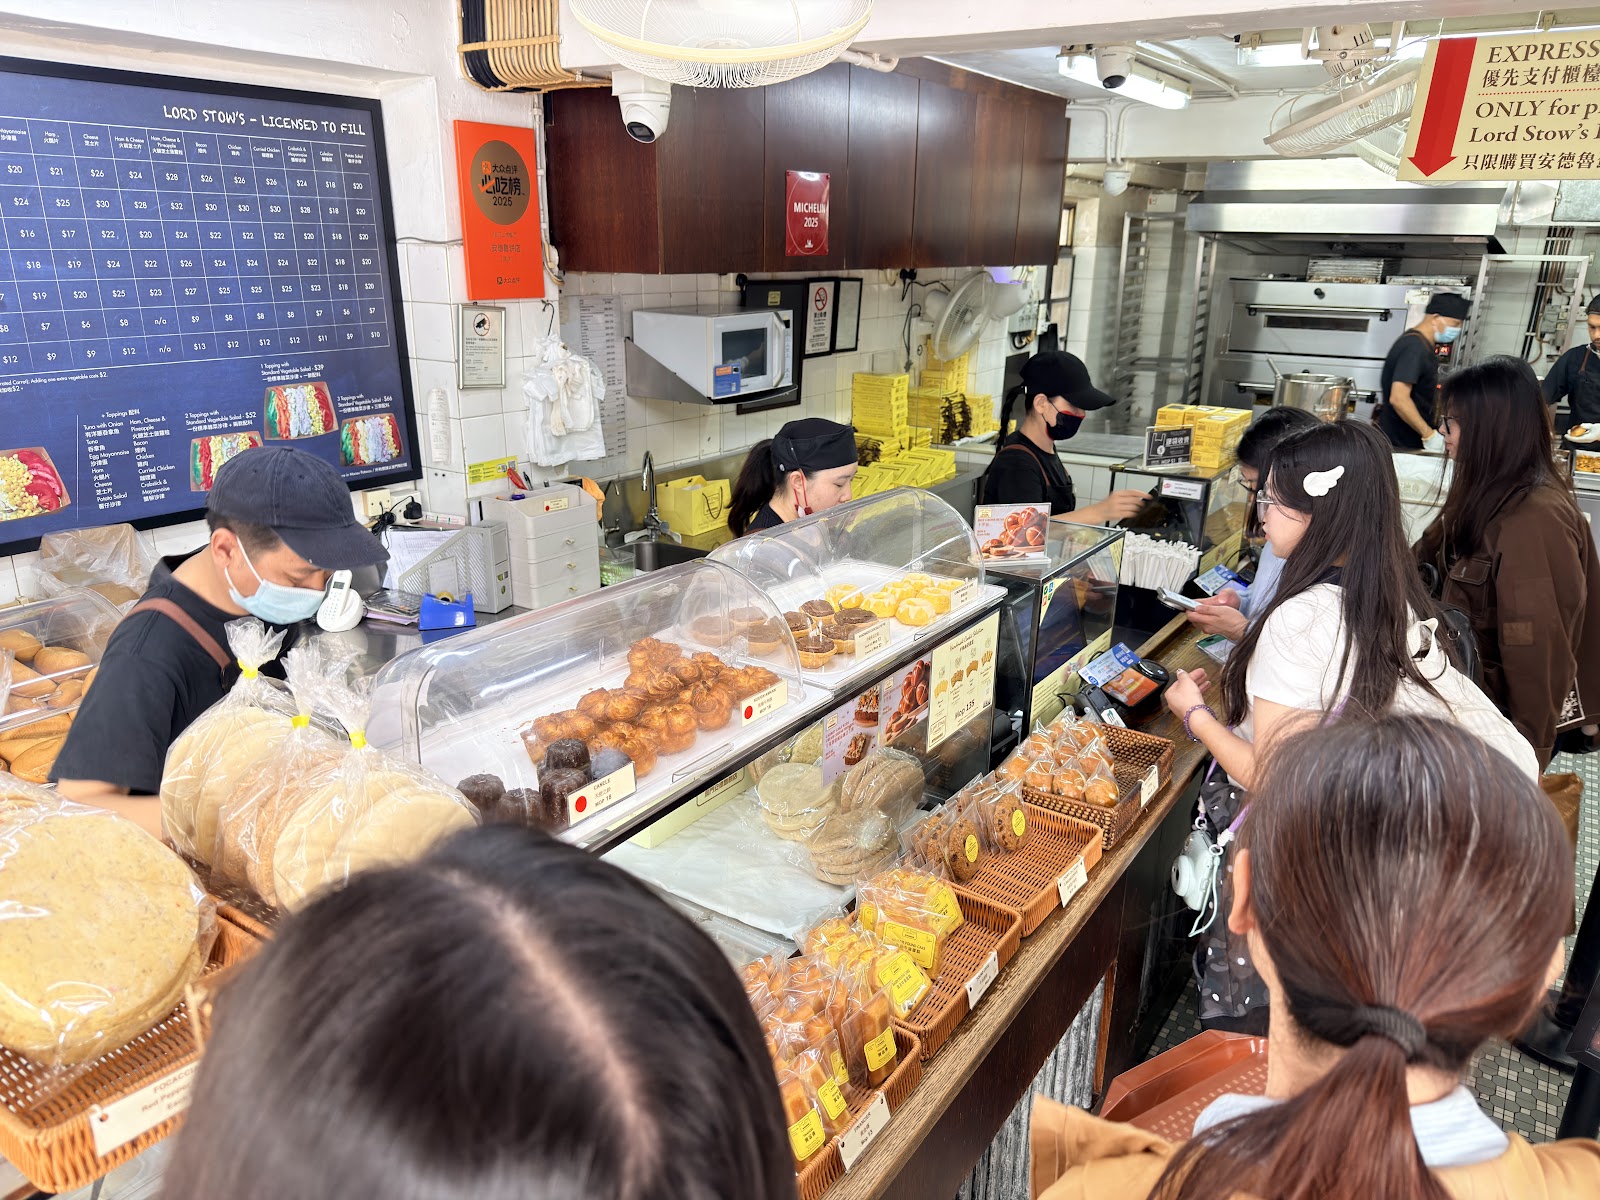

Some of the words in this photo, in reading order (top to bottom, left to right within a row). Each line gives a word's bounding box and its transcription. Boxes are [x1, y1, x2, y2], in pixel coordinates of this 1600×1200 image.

[1486, 39, 1600, 64] EXPRESS
[1475, 100, 1545, 119] ONLY
[1548, 98, 1580, 116] for
[164, 106, 197, 121] LORD
[202, 109, 245, 125] STOW'S
[261, 115, 318, 131] LICENSED
[321, 121, 336, 133] TO
[341, 124, 366, 135] FILL
[1468, 125, 1518, 142] Lord
[1523, 123, 1589, 142] Stow's
[492, 164, 518, 174] 大众点评
[1462, 151, 1600, 170] 只限購買安德魯
[8, 165, 22, 174] $20
[50, 167, 63, 176] $21
[91, 169, 104, 178] $26
[129, 171, 142, 179] $24
[166, 172, 178, 181] $28
[201, 174, 212, 183] $26
[234, 176, 245, 185] $26
[266, 178, 277, 186] $26
[297, 179, 307, 187] $24
[326, 180, 335, 189] $18
[353, 182, 363, 190] $20
[480, 174, 521, 196] 必吃榜
[14, 197, 29, 206] $24
[56, 198, 70, 207] $25
[96, 199, 109, 208] $30
[134, 201, 147, 209] $28
[171, 202, 183, 210] $32
[205, 203, 217, 211] $30
[238, 204, 249, 212] $30
[270, 205, 281, 213] $30
[300, 206, 310, 214] $28
[329, 207, 339, 215] $18
[356, 208, 365, 216] $20
[492, 196, 513, 206] 2025
[794, 202, 826, 214] MICHELIN
[804, 217, 819, 228] 2025
[20, 229, 35, 238] $16
[62, 229, 75, 238] $17
[102, 230, 115, 238] $22
[140, 230, 152, 239] $20
[176, 231, 188, 239] $24
[210, 231, 221, 239] $22
[243, 231, 253, 240] $22
[274, 232, 285, 240] $22
[304, 232, 314, 240] $20
[359, 233, 368, 241] $20
[27, 260, 41, 269] $18
[68, 260, 81, 269] $19
[107, 260, 120, 268] $24
[145, 259, 157, 268] $22
[180, 259, 192, 268] $26
[214, 259, 226, 267] $24
[247, 259, 258, 267] $24
[278, 258, 288, 267] $24
[307, 258, 317, 266] $22
[335, 258, 345, 266] $18
[362, 258, 371, 266] $20
[33, 291, 47, 300] $19
[74, 290, 87, 299] $20
[113, 289, 125, 298] $25
[150, 288, 162, 297] $23
[185, 287, 196, 296] $27
[219, 286, 230, 295] $25
[251, 286, 262, 294] $25
[282, 285, 292, 293] $25
[311, 284, 321, 292] $23
[339, 283, 348, 291] $18
[365, 282, 374, 290] $20
[41, 322, 50, 331] $7
[82, 320, 90, 329] $6
[120, 318, 128, 327] $8
[192, 315, 199, 324] $9
[225, 313, 233, 322] $8
[257, 312, 264, 320] $8
[287, 311, 294, 319] $8
[316, 309, 322, 317] $7
[343, 308, 350, 316] $6
[3, 355, 18, 364] $12
[47, 352, 56, 361] $9
[87, 349, 96, 358] $9
[123, 347, 135, 356] $12
[194, 342, 206, 351] $13
[228, 340, 239, 349] $12
[260, 338, 270, 346] $12
[290, 336, 300, 344] $12
[318, 334, 327, 342] $11
[100, 450, 130, 458] Mayonnaise
[141, 480, 162, 488] Crabstick
[142, 487, 170, 495] Mayonnaise
[113, 492, 128, 500] Salad
[153, 1068, 194, 1093] FOCACCI
